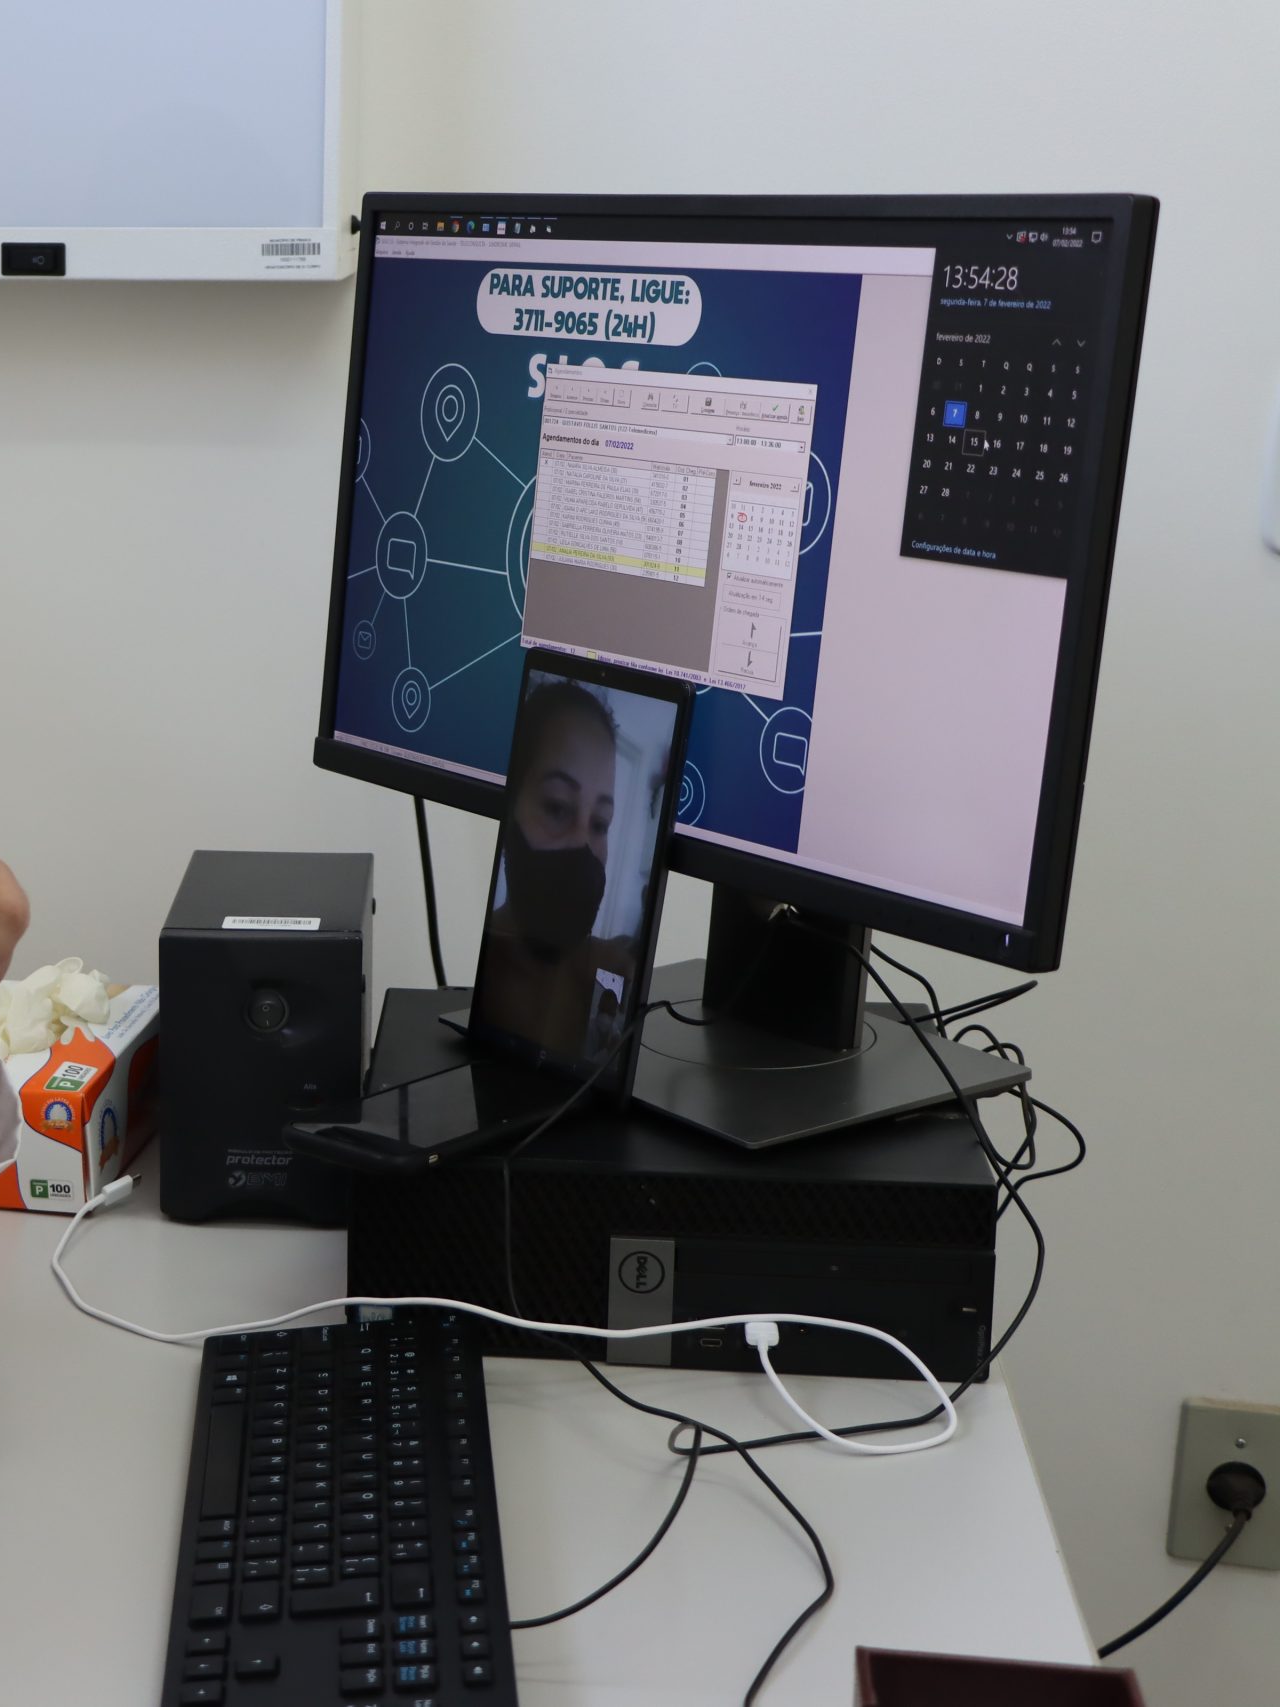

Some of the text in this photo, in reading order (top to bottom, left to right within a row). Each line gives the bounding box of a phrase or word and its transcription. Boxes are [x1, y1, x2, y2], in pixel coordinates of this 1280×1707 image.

[1061, 226, 1077, 236] 13:54
[1052, 238, 1084, 248] 07/02/2022
[943, 265, 1019, 291] 13:54:28
[489, 273, 690, 305] PARA SUPORTE, LIGUE:
[989, 299, 997, 307] de
[998, 299, 1025, 309] fevereiro
[1026, 300, 1034, 309] de
[1035, 301, 1052, 310] 2022
[513, 308, 656, 343] 3711-9065 (24H)
[936, 332, 991, 344] fevereiro de 2022
[936, 357, 1080, 374] D S T Q Q S S
[978, 384, 1077, 400] 1 2 3 4 5
[930, 407, 1076, 428] 6 7 8 9 10 11 12
[542, 432, 599, 447] Agendamentos do dia
[605, 439, 634, 451] 07/02/2022
[926, 433, 1072, 455] 13 14 15 16 17 18 19
[922, 459, 1068, 483] 20 21 22 23 24 25 26
[770, 482, 782, 491] 2022
[919, 485, 950, 497] 27 28
[911, 540, 952, 554] Configurações
[953, 546, 962, 554] de
[962, 547, 976, 557] data
[982, 550, 996, 560] hora
[62, 1065, 83, 1078] 100
[226, 1154, 293, 1166] protector
[35, 1184, 71, 1196] P 100
[635, 1255, 648, 1289] DELL
